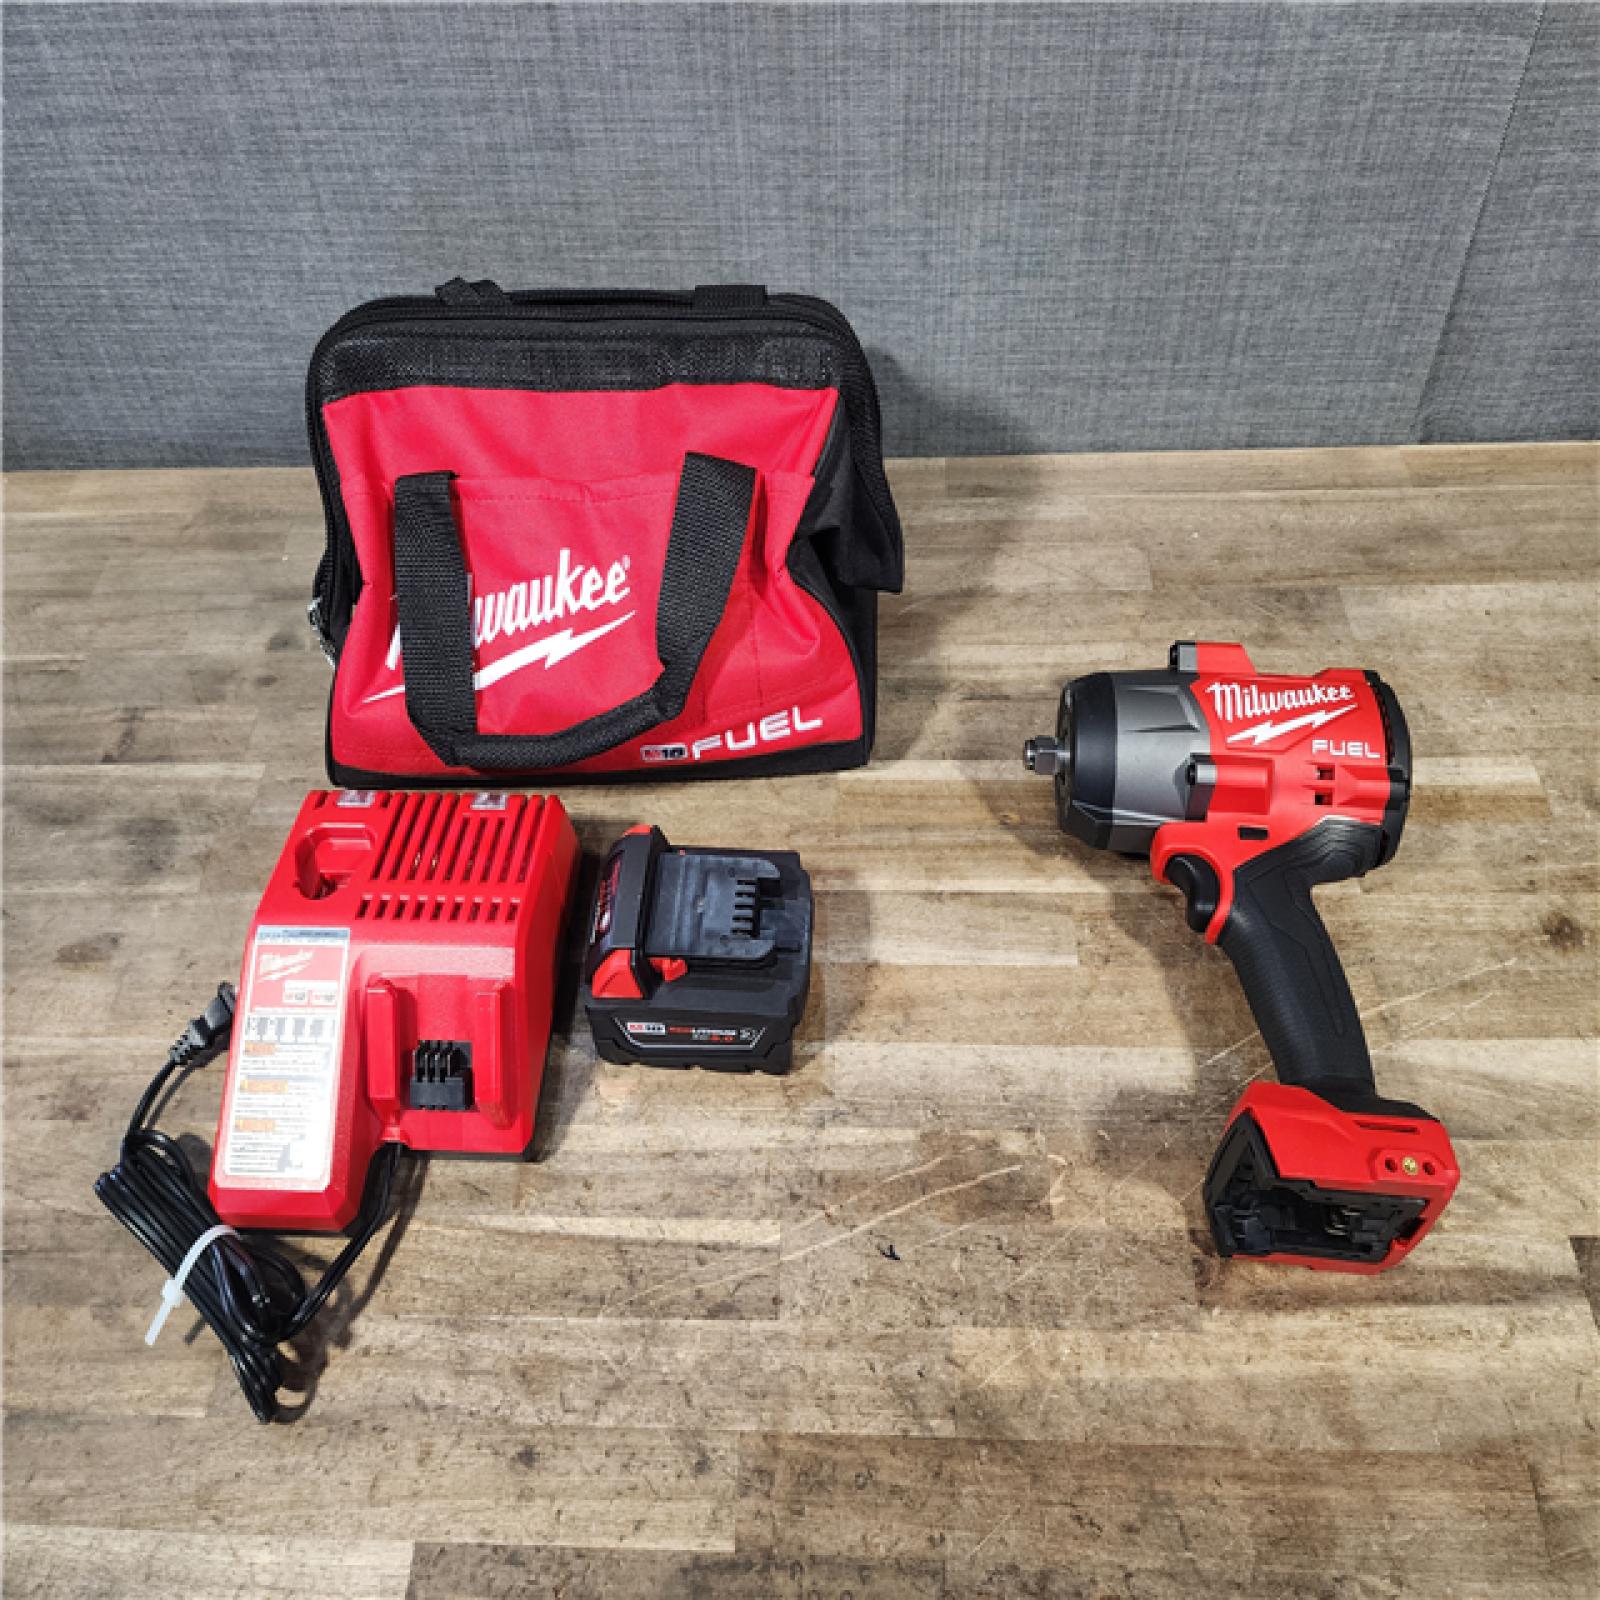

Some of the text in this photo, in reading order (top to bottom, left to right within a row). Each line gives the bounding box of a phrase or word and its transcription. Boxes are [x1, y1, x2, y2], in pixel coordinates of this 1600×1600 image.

[385, 547, 631, 670] waukee
[1205, 682, 1355, 722] Milwaukee
[692, 706, 823, 760] FUEL
[1311, 739, 1380, 758] FUEL
